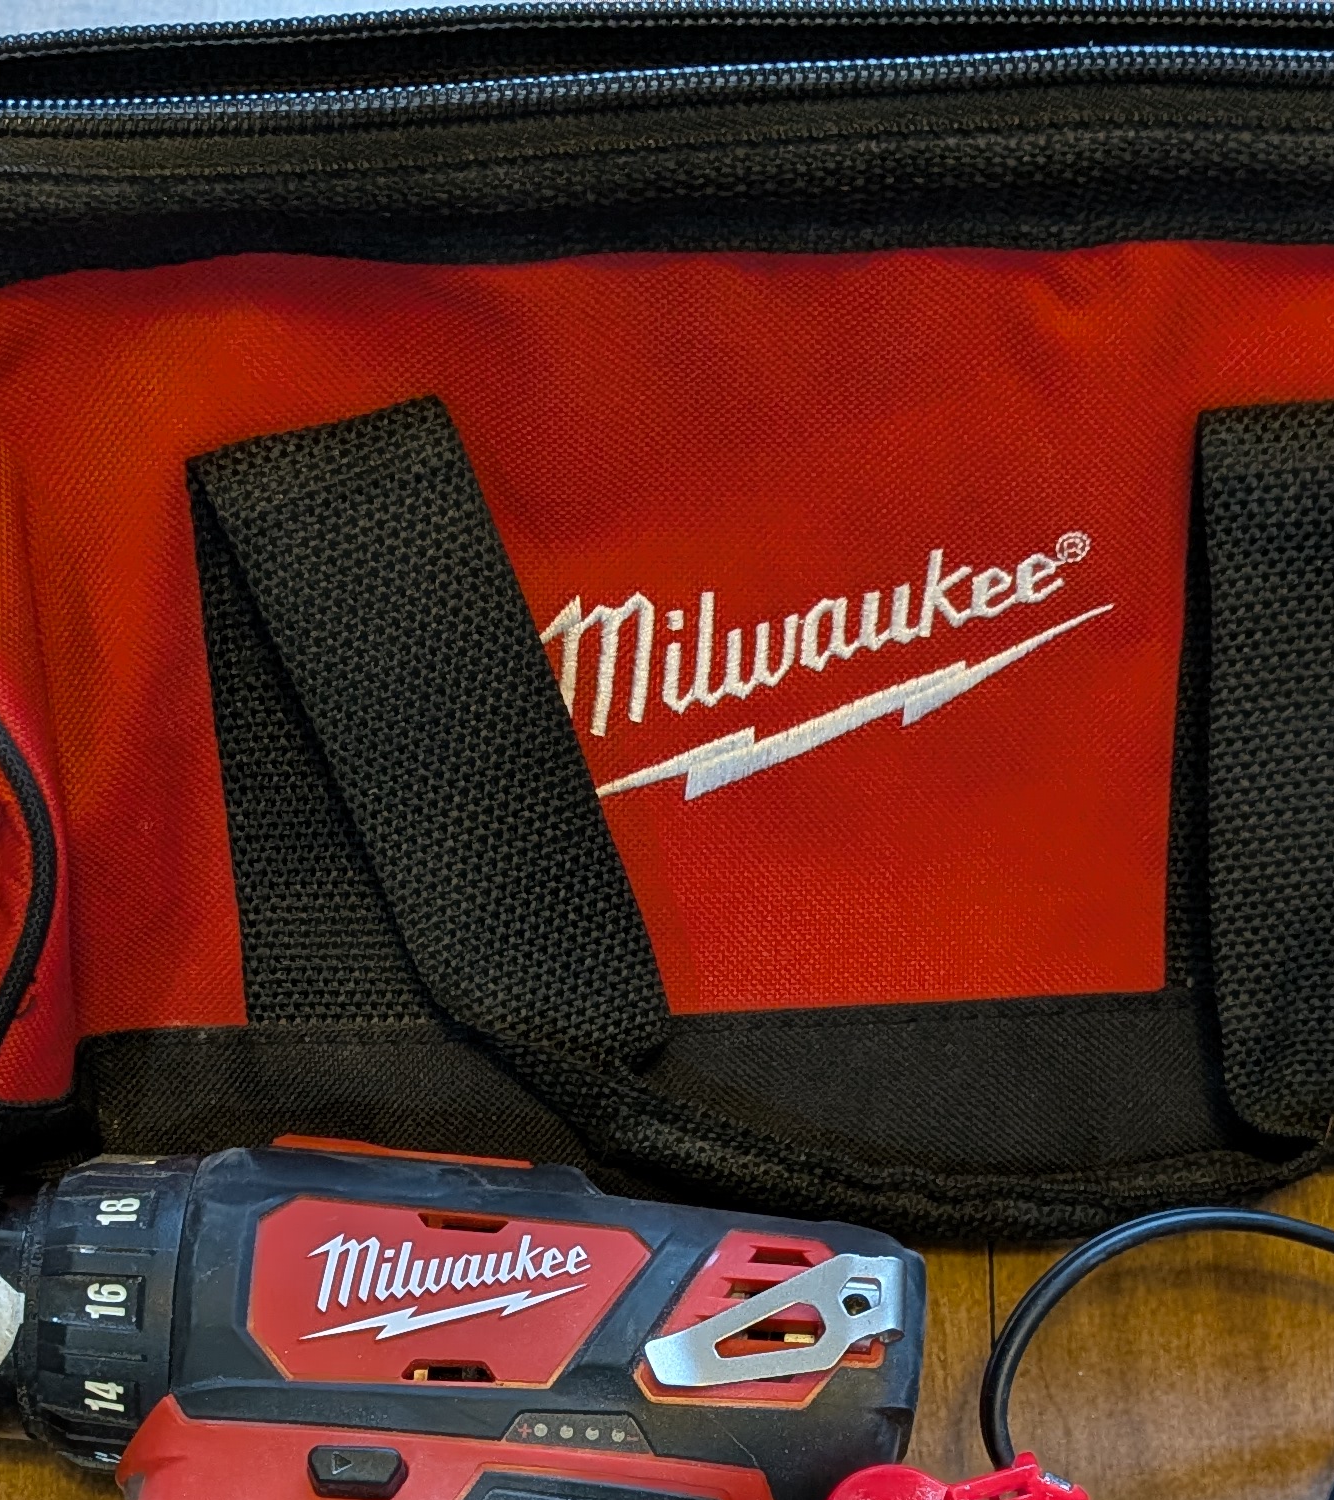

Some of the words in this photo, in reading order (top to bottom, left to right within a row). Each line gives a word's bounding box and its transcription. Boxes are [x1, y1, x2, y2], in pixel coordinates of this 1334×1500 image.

[96, 1197, 141, 1226] 18
[308, 1232, 592, 1313] Milwaukee
[85, 1282, 128, 1319] 16
[84, 1380, 125, 1413] 14
